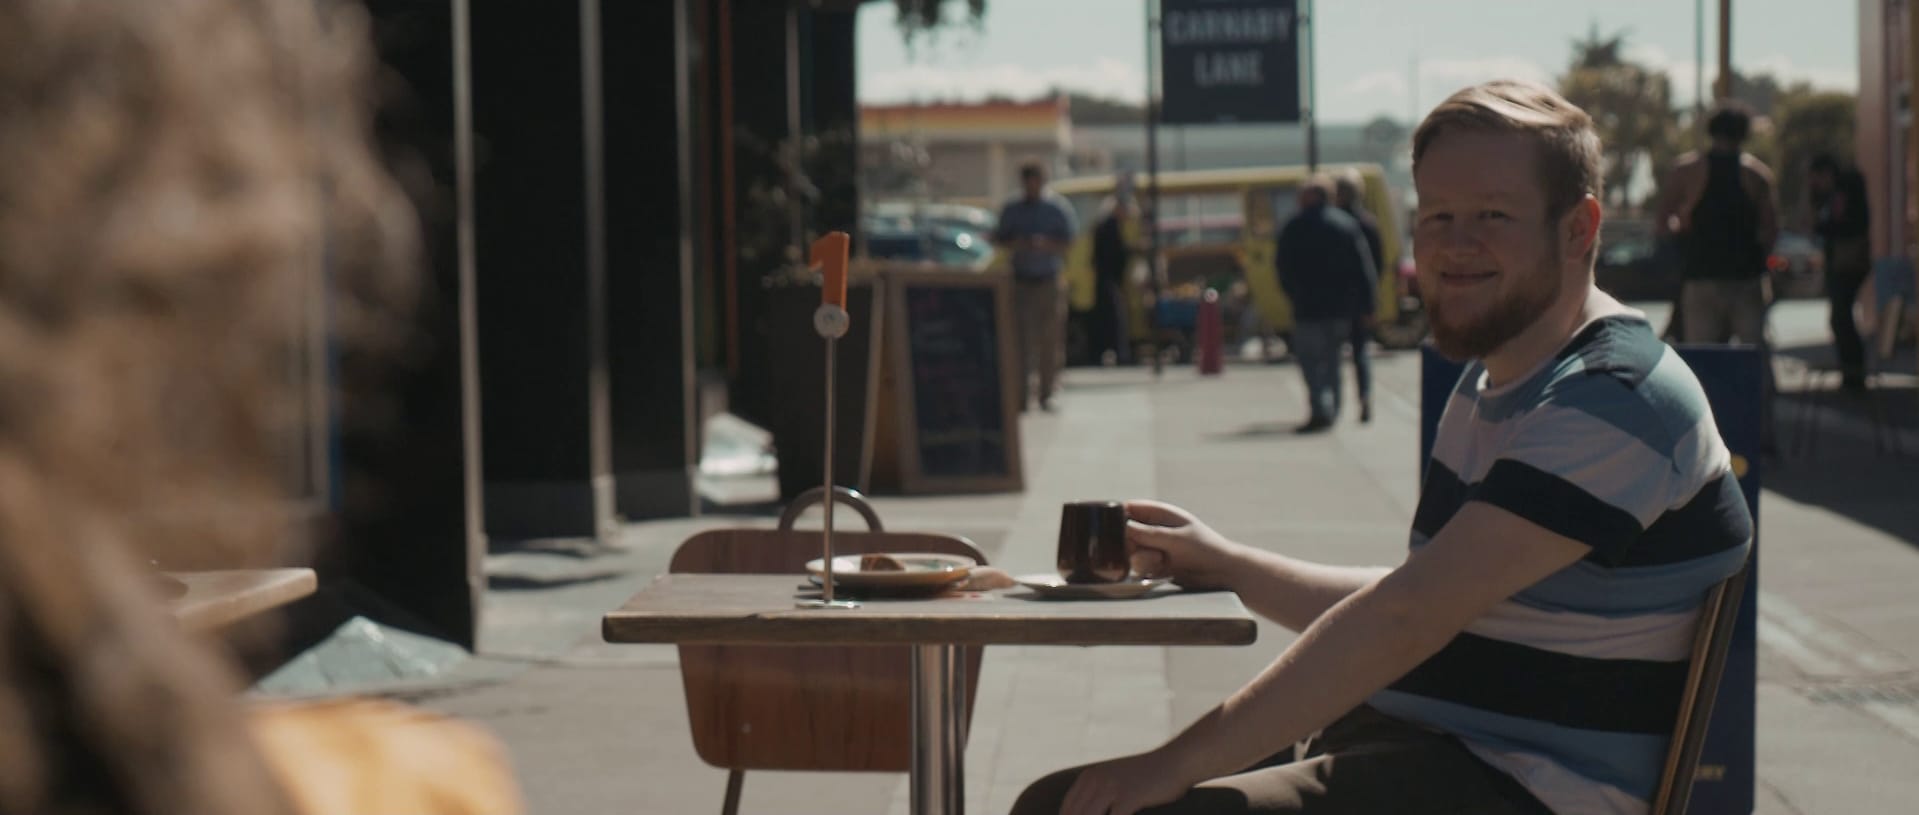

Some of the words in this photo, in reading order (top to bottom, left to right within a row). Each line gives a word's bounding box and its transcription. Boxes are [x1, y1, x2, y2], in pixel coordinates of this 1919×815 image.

[1166, 9, 1291, 43] CARNABY
[1193, 51, 1264, 86] LANE
[809, 231, 850, 310] 1
